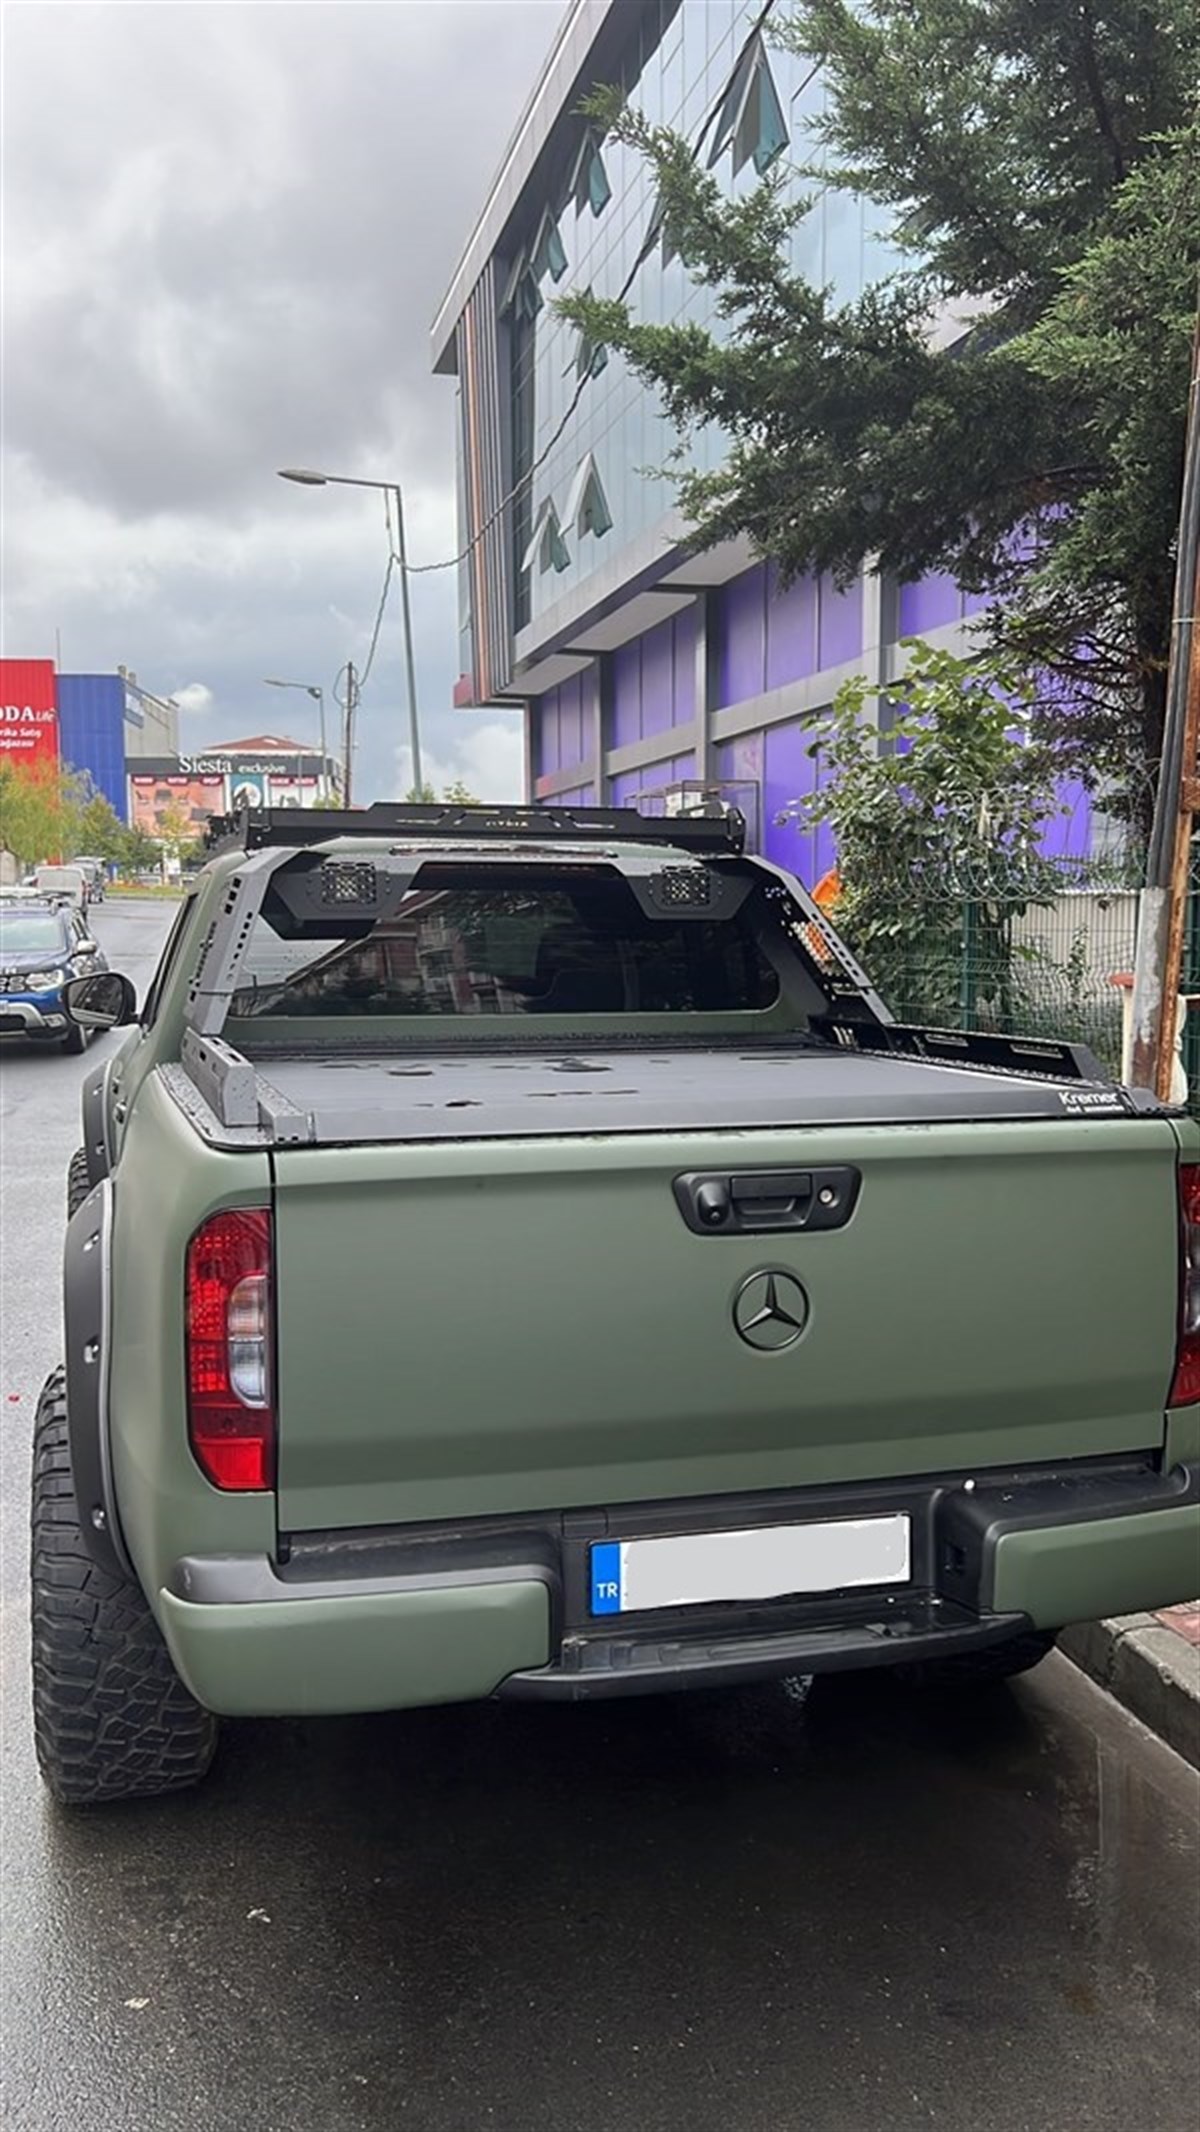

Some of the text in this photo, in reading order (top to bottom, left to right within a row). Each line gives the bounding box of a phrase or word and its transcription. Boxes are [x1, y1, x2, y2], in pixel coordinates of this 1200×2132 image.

[179, 754, 287, 774] Siesta exclusive
[1058, 1092, 1118, 1105] Kremer
[597, 1582, 618, 1599] TR
